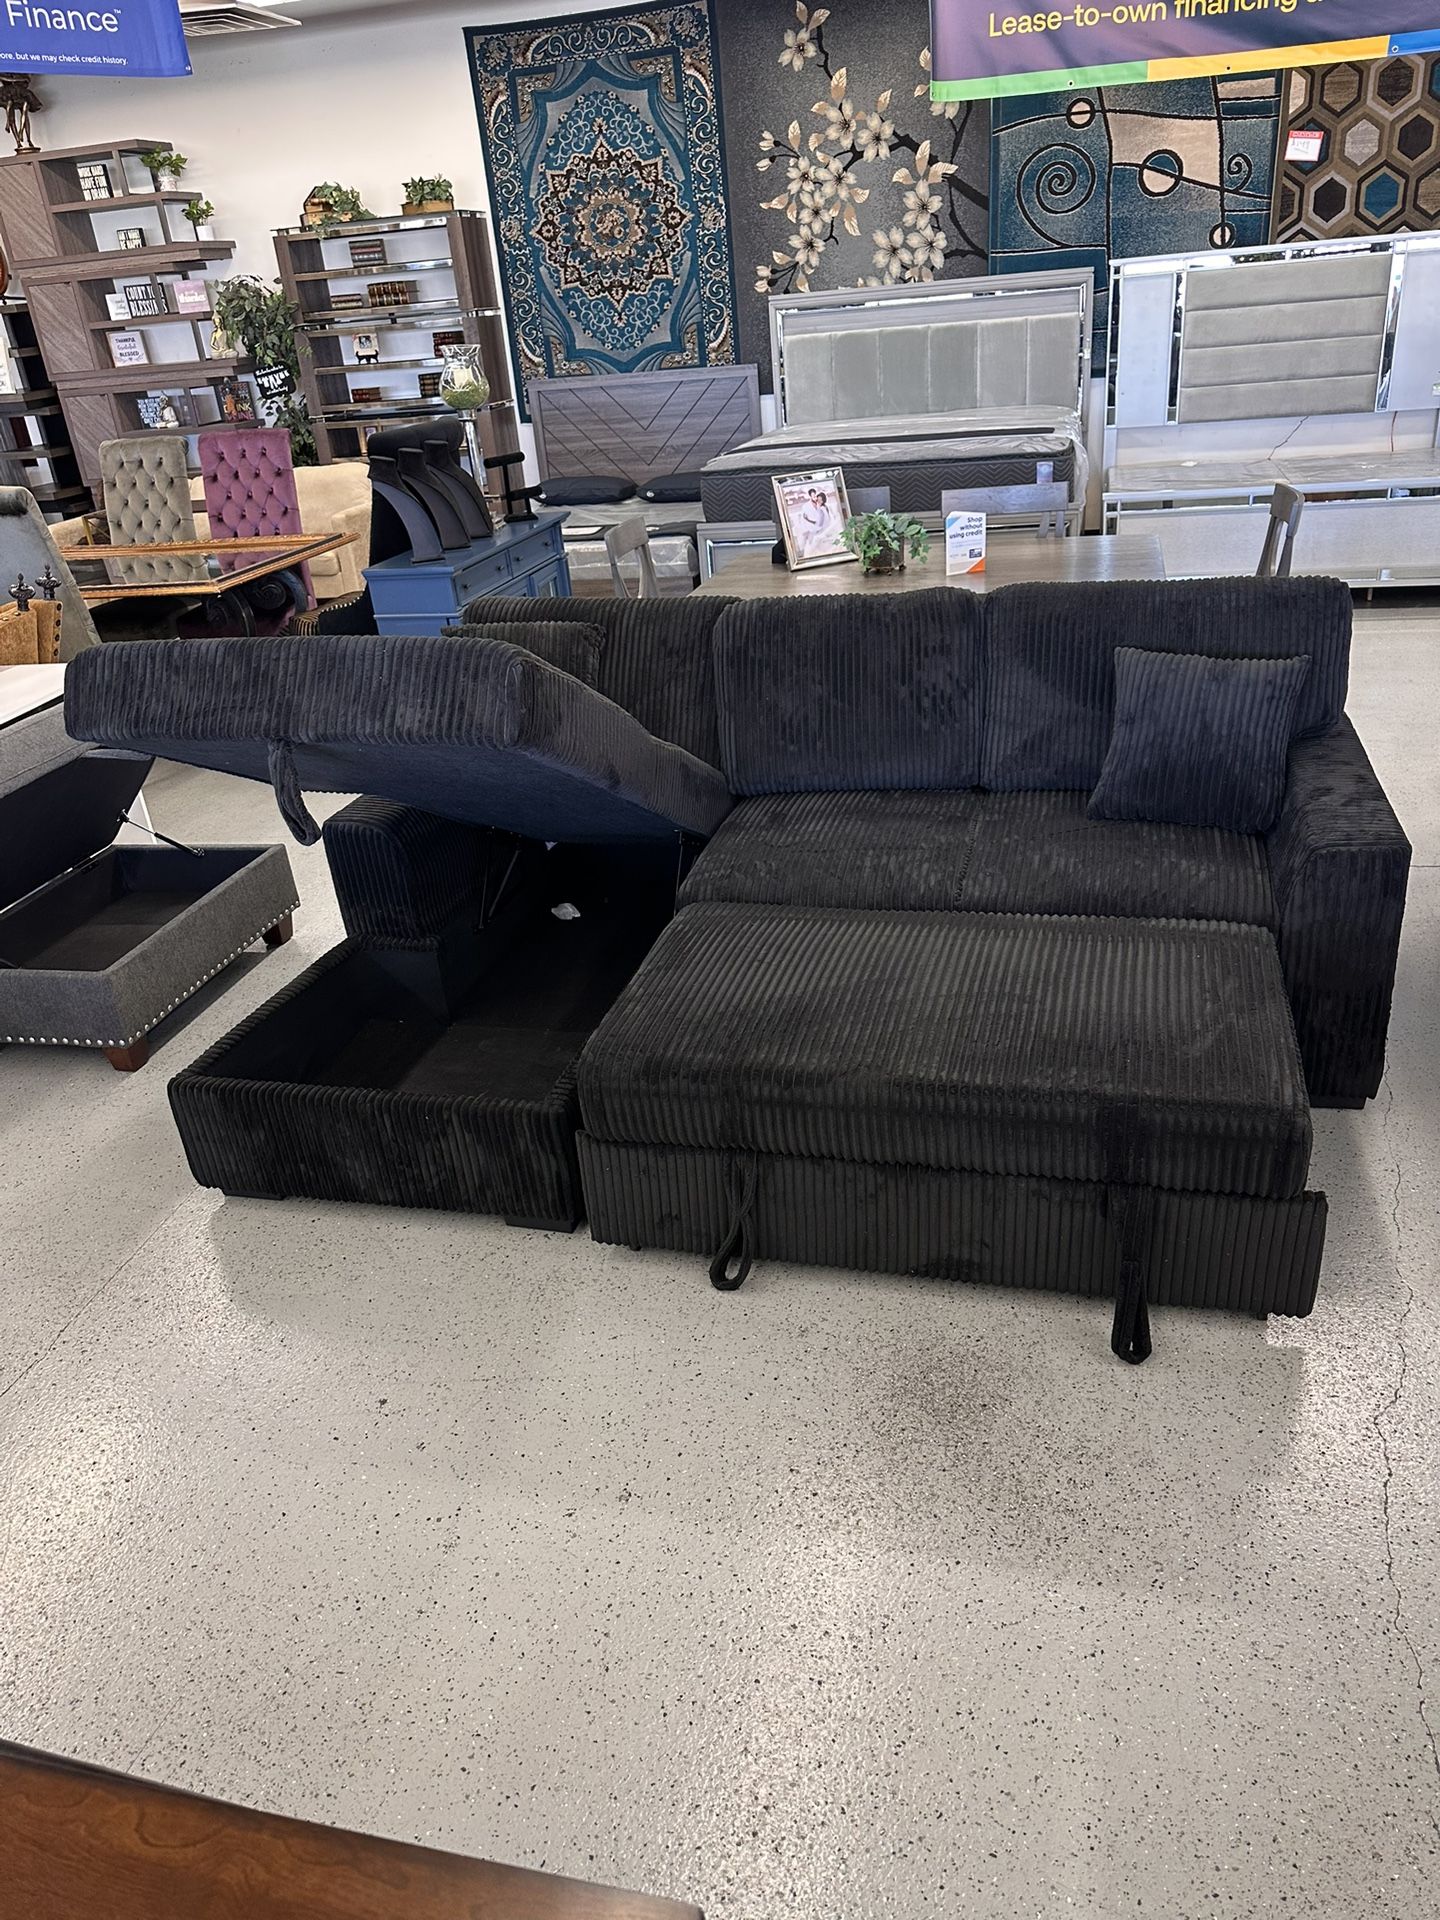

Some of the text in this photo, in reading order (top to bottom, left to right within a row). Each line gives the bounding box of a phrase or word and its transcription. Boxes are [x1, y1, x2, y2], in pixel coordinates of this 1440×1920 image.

[989, 2, 1167, 37] Lease-to-own
[15, 52, 29, 60] but
[41, 54, 57, 63] may
[58, 54, 80, 62] check
[102, 56, 128, 66] history.
[80, 176, 107, 190] HAVE FUN
[126, 286, 147, 300] COUNT
[129, 299, 168, 316] BLESSINS
[223, 402, 252, 413] DINK
[960, 523, 983, 531] without
[965, 529, 983, 537] credit
[965, 529, 983, 537] credit
